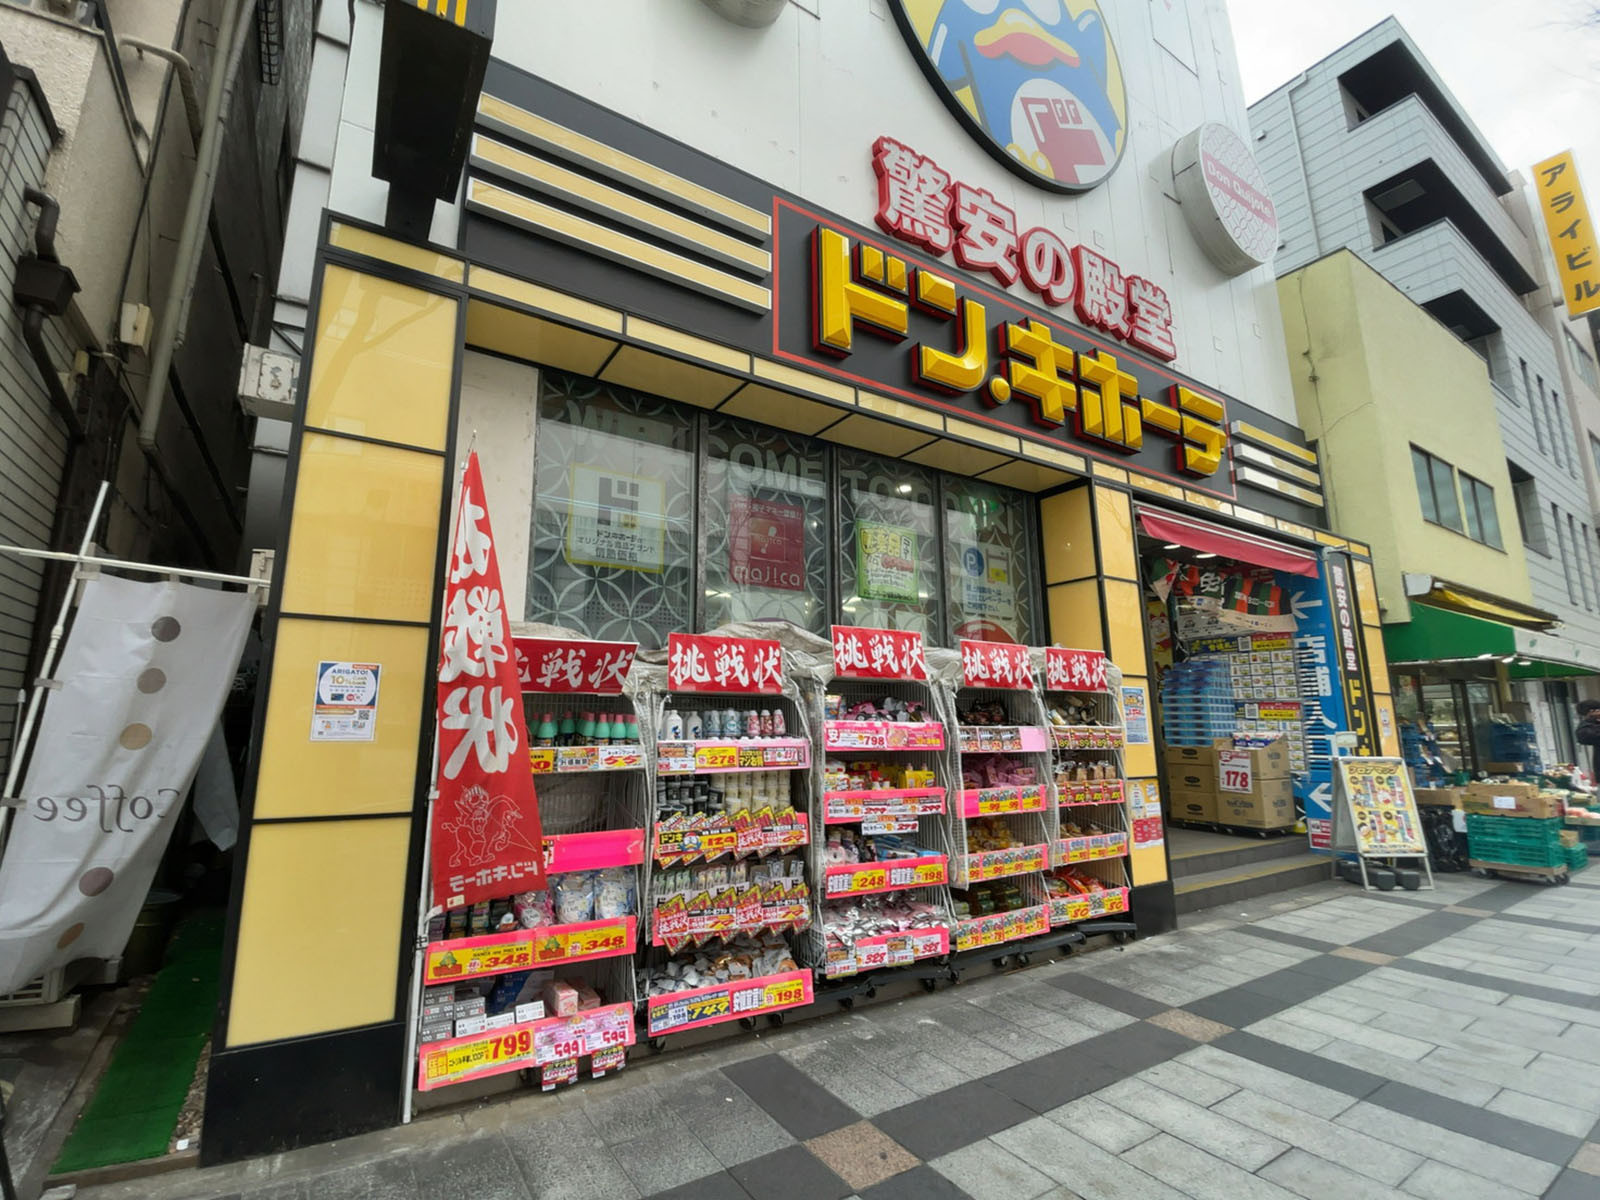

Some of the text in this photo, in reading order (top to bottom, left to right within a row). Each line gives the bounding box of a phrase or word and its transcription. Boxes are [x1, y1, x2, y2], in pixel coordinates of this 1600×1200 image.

[1541, 162, 1600, 302] アライビル
[872, 136, 1176, 362] 驚安の殿堂
[835, 632, 927, 676] 挑戦状
[670, 642, 783, 689] 挑戦状
[964, 647, 1034, 687] 挑戦状
[1048, 653, 1108, 688] 挑戦状
[863, 735, 885, 746] 798
[709, 756, 735, 764] 278
[1225, 770, 1249, 787] 178
[860, 875, 884, 887] 248
[924, 871, 942, 880] 198
[584, 935, 625, 951] 348
[484, 952, 530, 968] 348
[776, 989, 802, 1002] 198
[489, 1030, 531, 1060] 799
